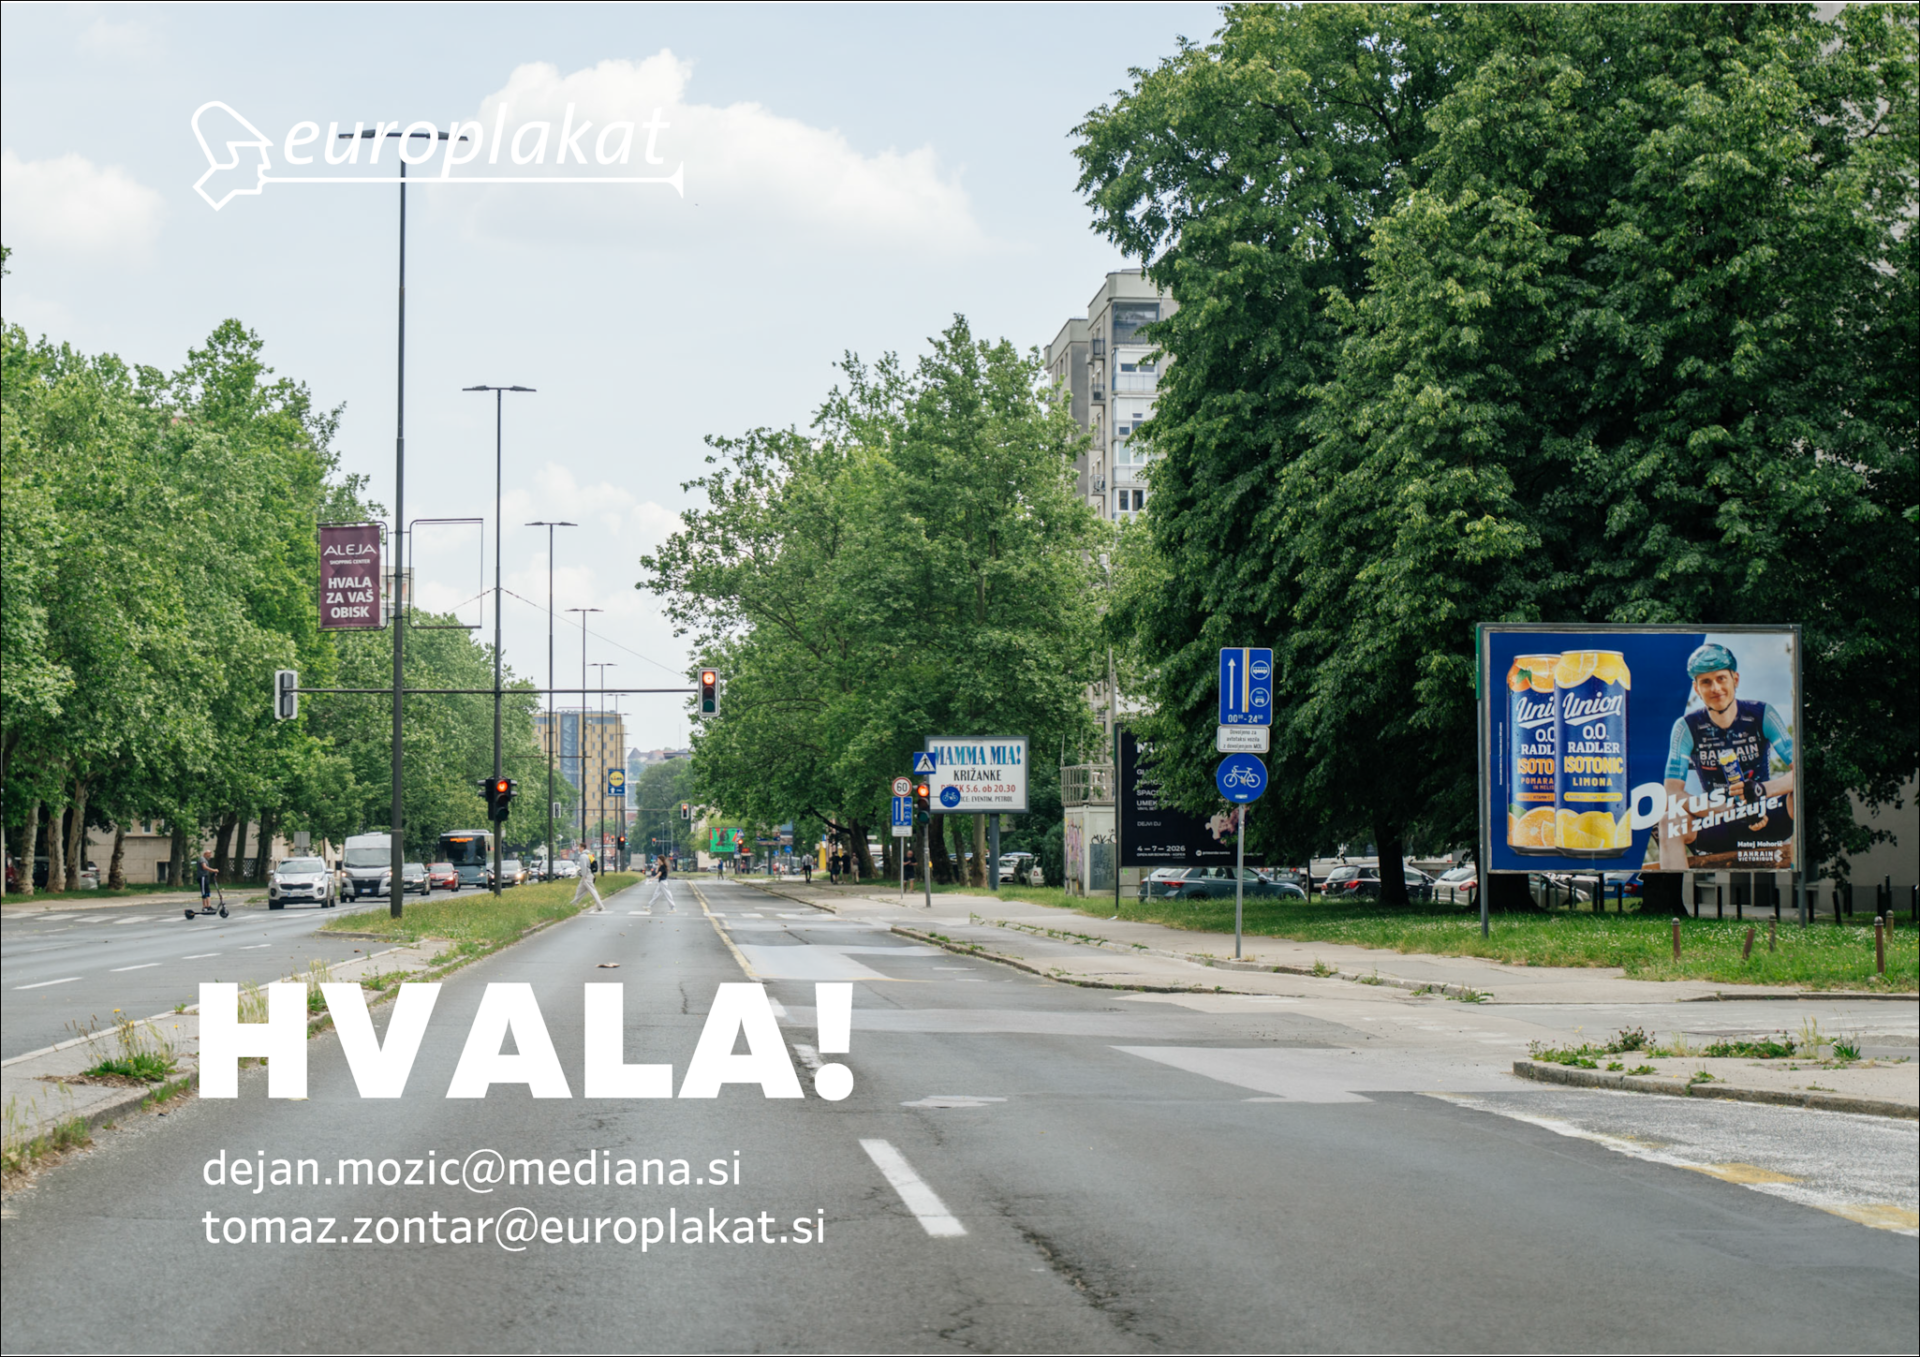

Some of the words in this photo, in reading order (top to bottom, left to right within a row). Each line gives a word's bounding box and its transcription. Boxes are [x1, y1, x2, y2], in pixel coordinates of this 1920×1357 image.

[323, 544, 377, 556] ALEJA
[328, 577, 373, 589] HVALA
[326, 592, 344, 604] ZA
[347, 588, 374, 603] VAŠ
[330, 606, 370, 619] OBISK
[1562, 692, 1624, 720] Union
[1521, 743, 1555, 756] RADL
[1567, 741, 1621, 754] RADLER
[933, 745, 987, 765] MAMMA
[990, 745, 1022, 765] MIA!
[1517, 757, 1555, 775] ISOTO
[1563, 756, 1624, 774] ISOTONIC
[953, 767, 1002, 782] KRIŽANKE
[1520, 777, 1554, 785] POMARA
[896, 782, 908, 792] 60
[966, 784, 981, 793] 5.6.
[982, 784, 993, 793] ob
[994, 784, 1016, 793] 20.30
[1572, 777, 1613, 787] LIMONA
[1631, 782, 1736, 831] Okus,
[1667, 821, 1688, 839] ki
[1691, 795, 1784, 832] združuje.
[1737, 841, 1756, 849] Matej
